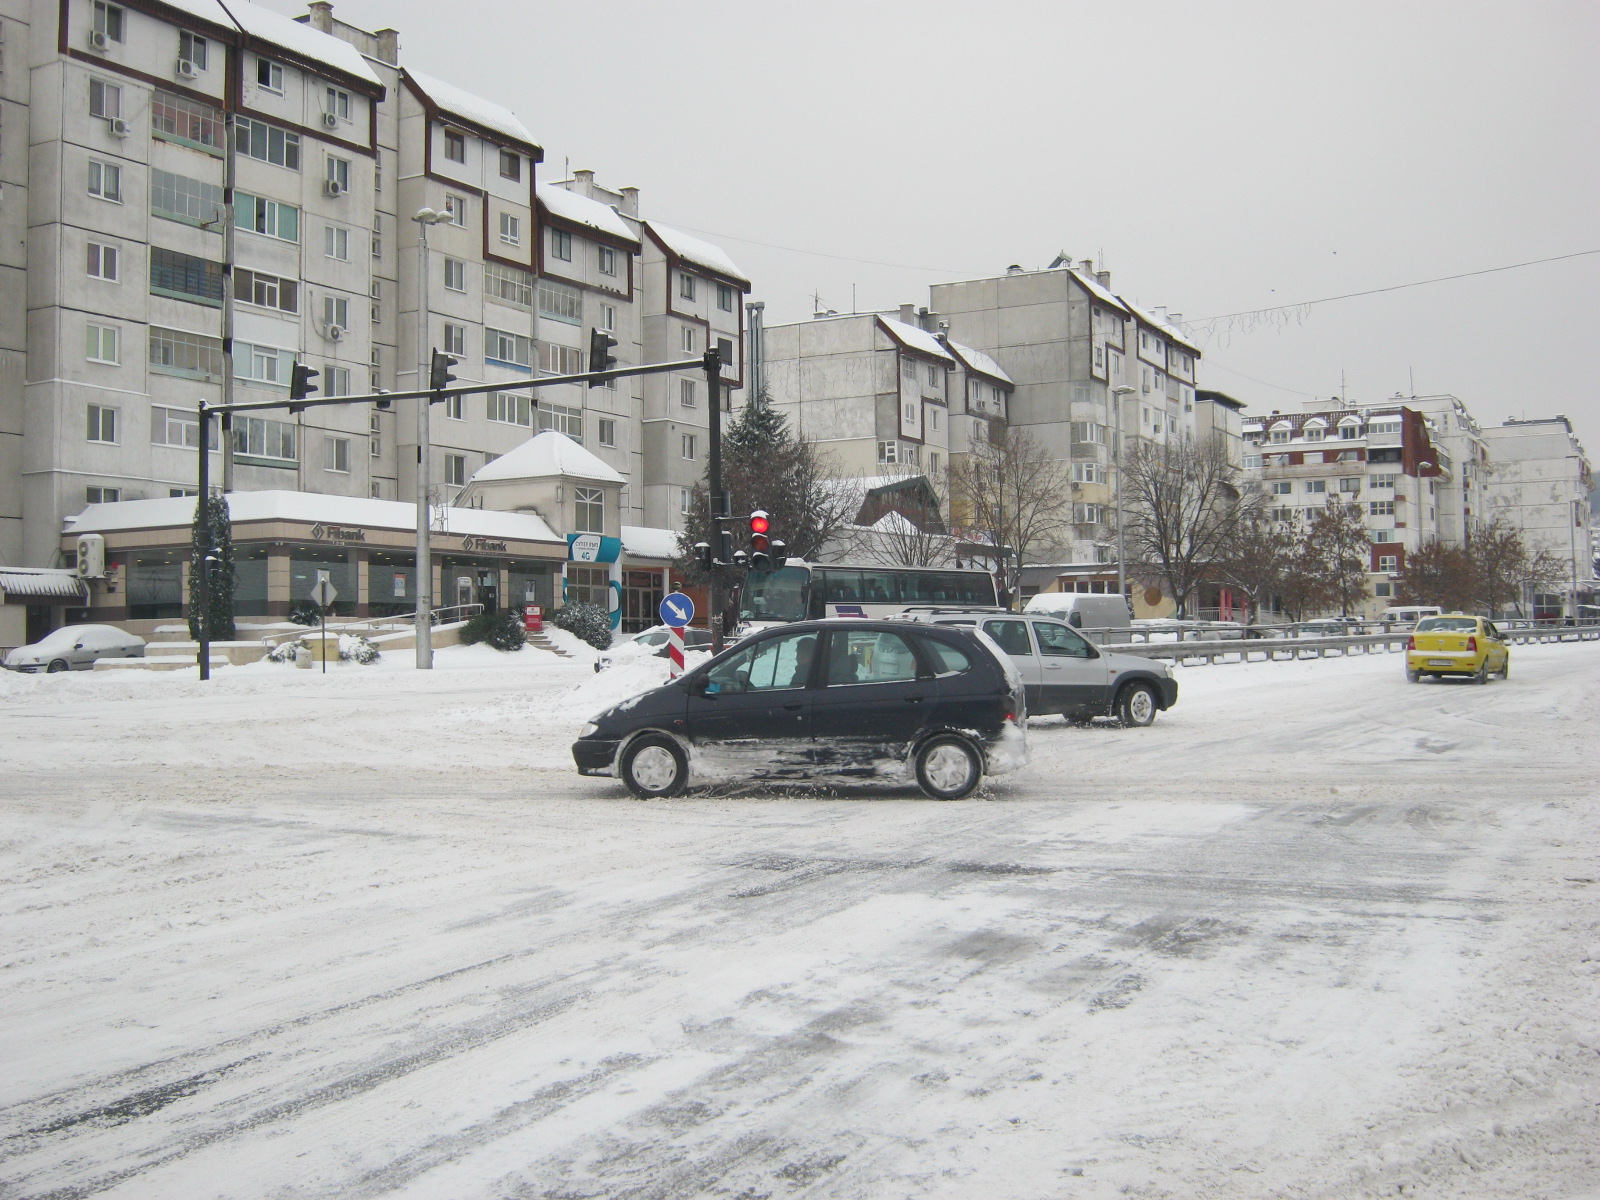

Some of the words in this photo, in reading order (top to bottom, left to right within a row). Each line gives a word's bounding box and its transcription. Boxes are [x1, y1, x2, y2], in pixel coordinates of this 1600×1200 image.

[327, 525, 366, 541] Fibank
[475, 538, 507, 551] Fibank
[582, 552, 590, 560] 4G
